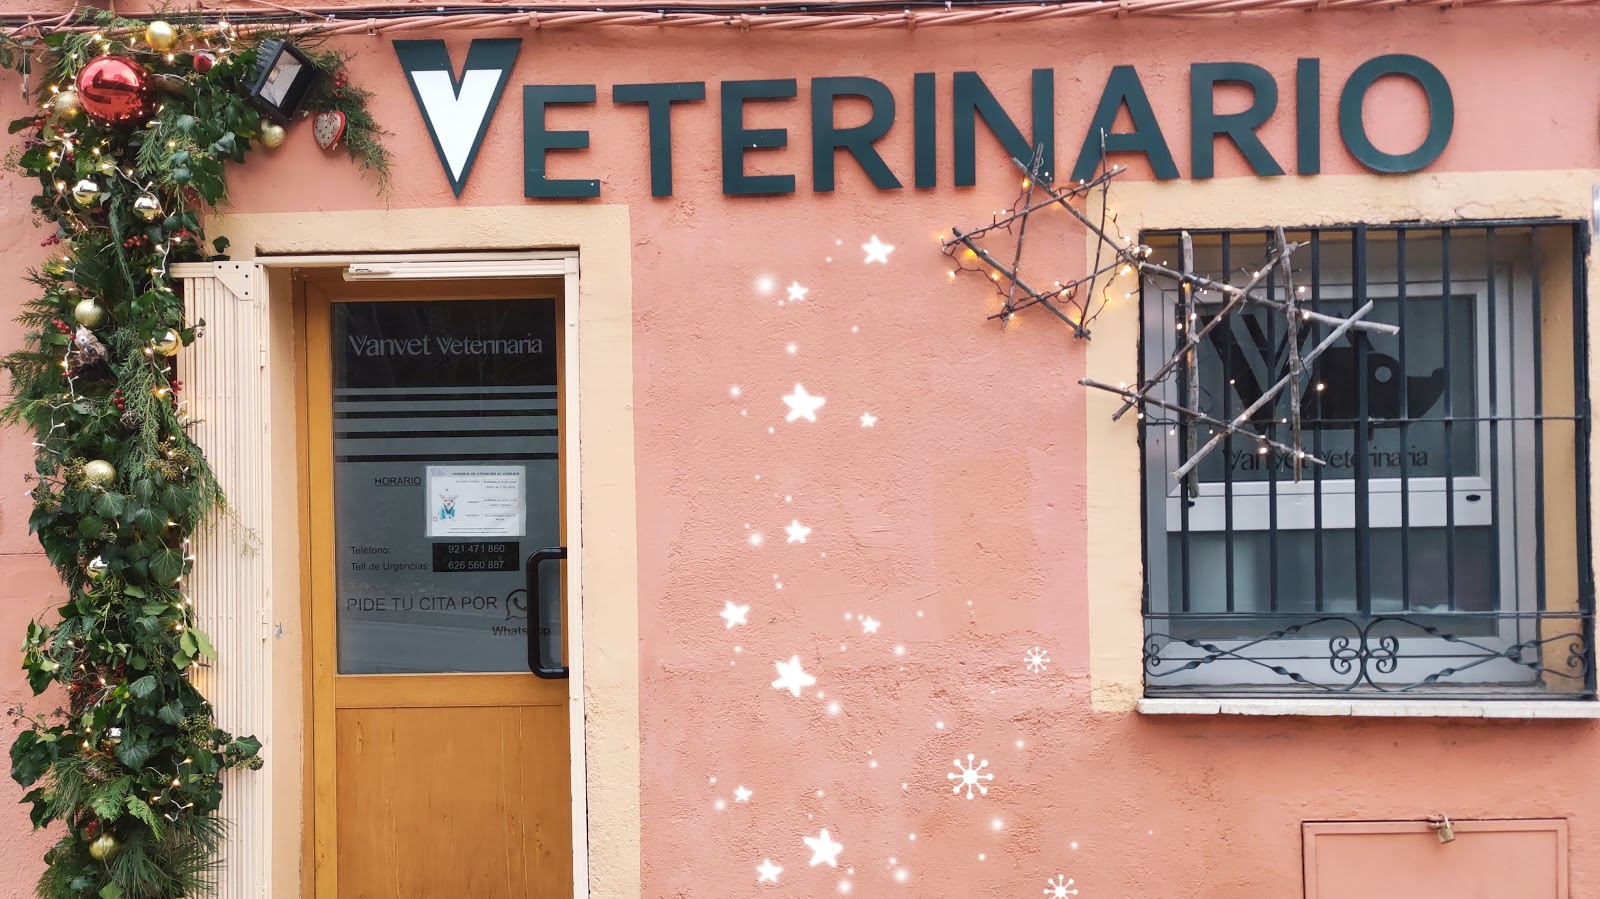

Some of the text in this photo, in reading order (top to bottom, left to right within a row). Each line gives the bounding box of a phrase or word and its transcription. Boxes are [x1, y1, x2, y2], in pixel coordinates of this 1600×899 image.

[391, 36, 1454, 200] VETERINARIO
[349, 332, 543, 357] Vanvet Veterinaria
[374, 476, 422, 487] HORARIO
[448, 544, 465, 554] 921
[468, 544, 485, 553] 471
[487, 544, 505, 553] 860
[368, 562, 380, 571] de
[448, 560, 466, 570] 626
[468, 560, 485, 570] 560
[487, 560, 505, 569] 887
[347, 596, 498, 612] PIDE TU CITA POR
[491, 625, 551, 637] Whatspp
